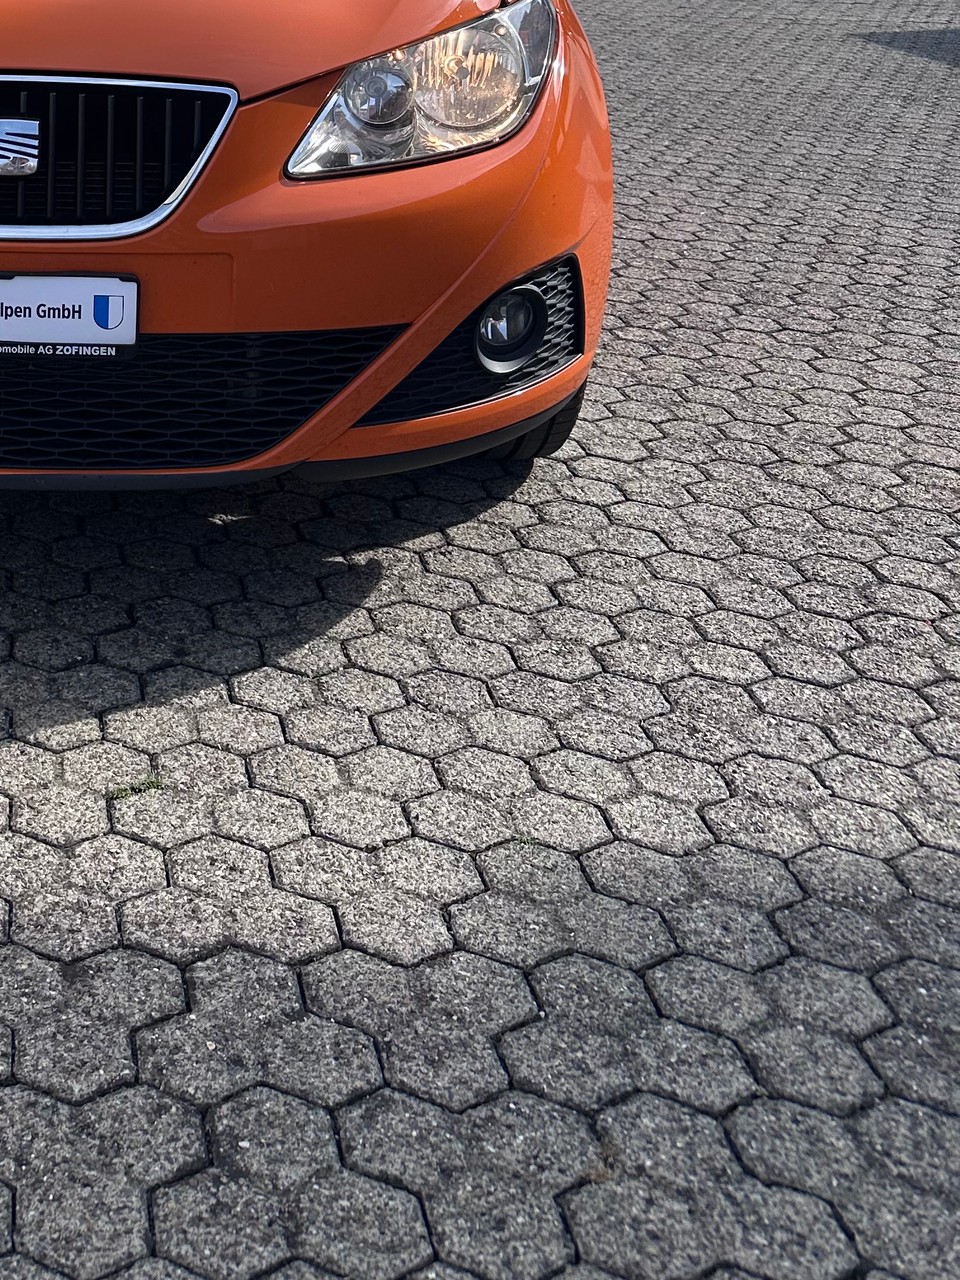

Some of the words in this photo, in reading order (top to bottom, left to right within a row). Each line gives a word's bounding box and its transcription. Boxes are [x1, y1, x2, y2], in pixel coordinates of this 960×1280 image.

[36, 303, 82, 320] GmbH
[37, 345, 54, 355] AG
[55, 345, 116, 356] ZOFINGEN
